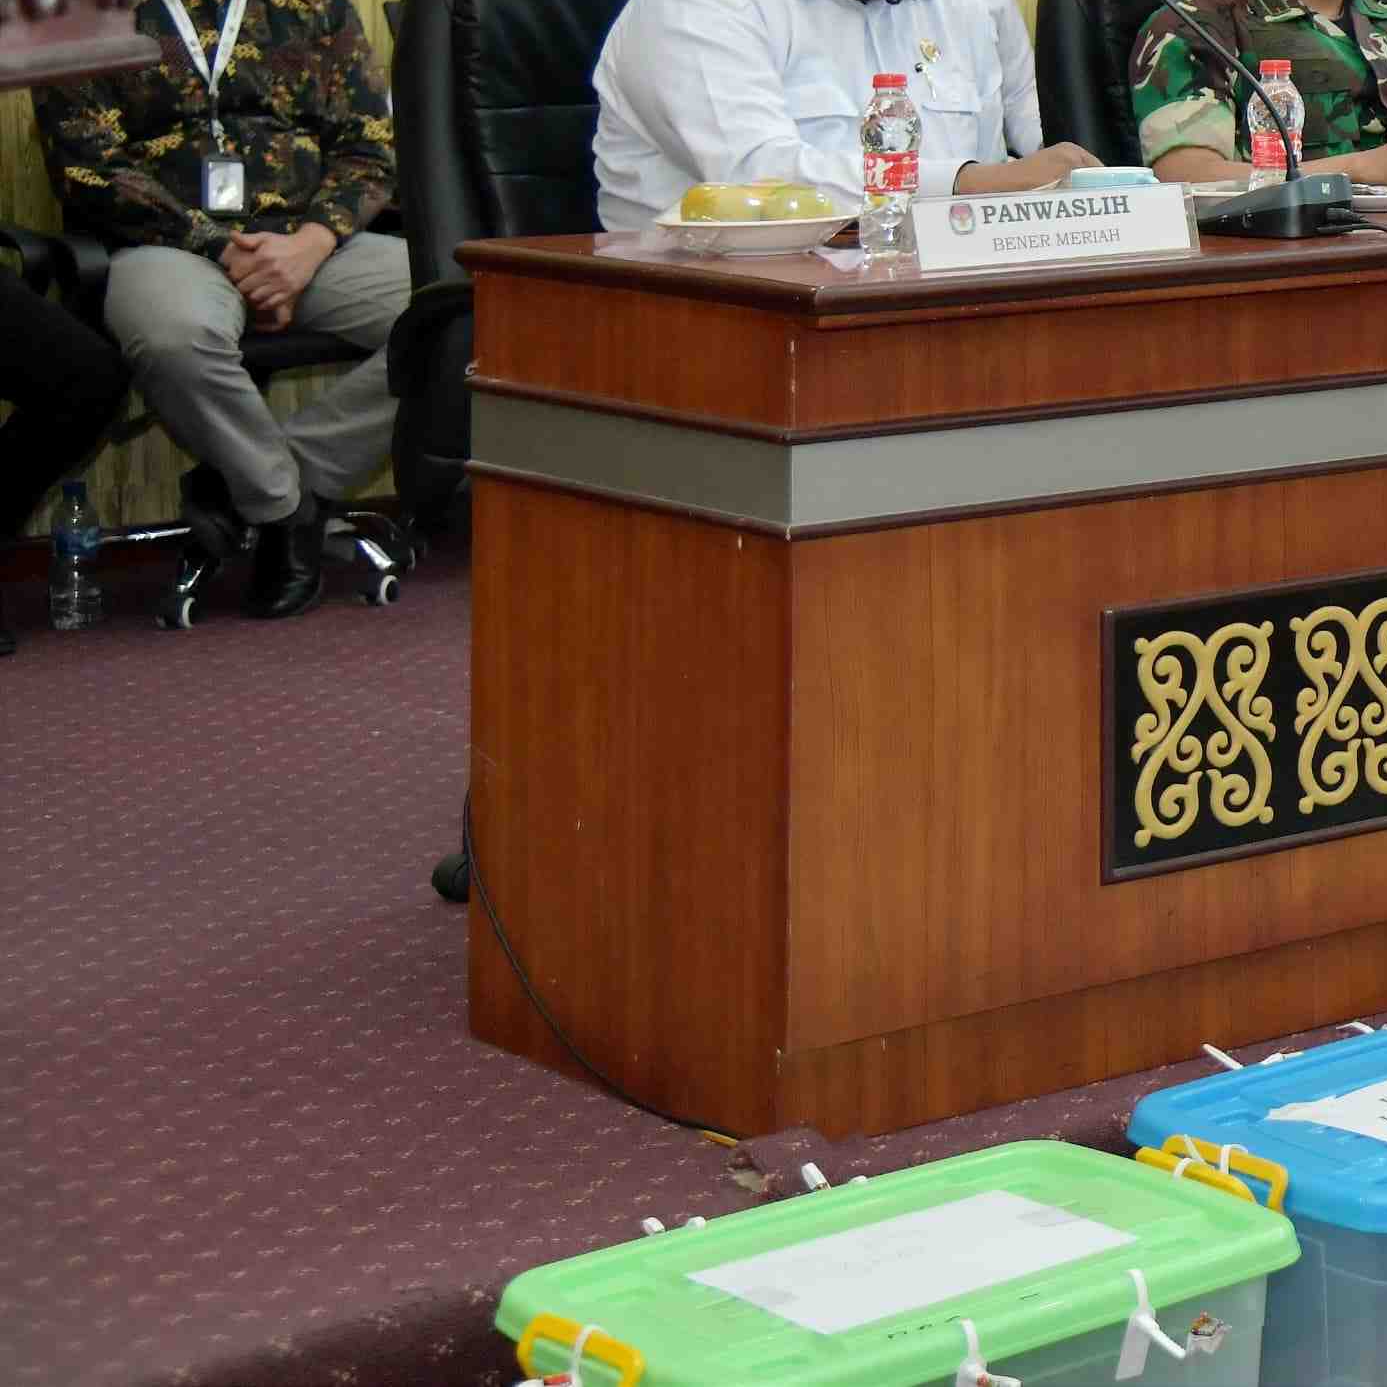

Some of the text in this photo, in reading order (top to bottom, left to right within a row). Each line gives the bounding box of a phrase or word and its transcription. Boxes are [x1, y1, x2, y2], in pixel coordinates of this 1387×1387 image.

[980, 194, 1132, 225] PANWASLIH
[992, 228, 1121, 252] BENER MERIAH
